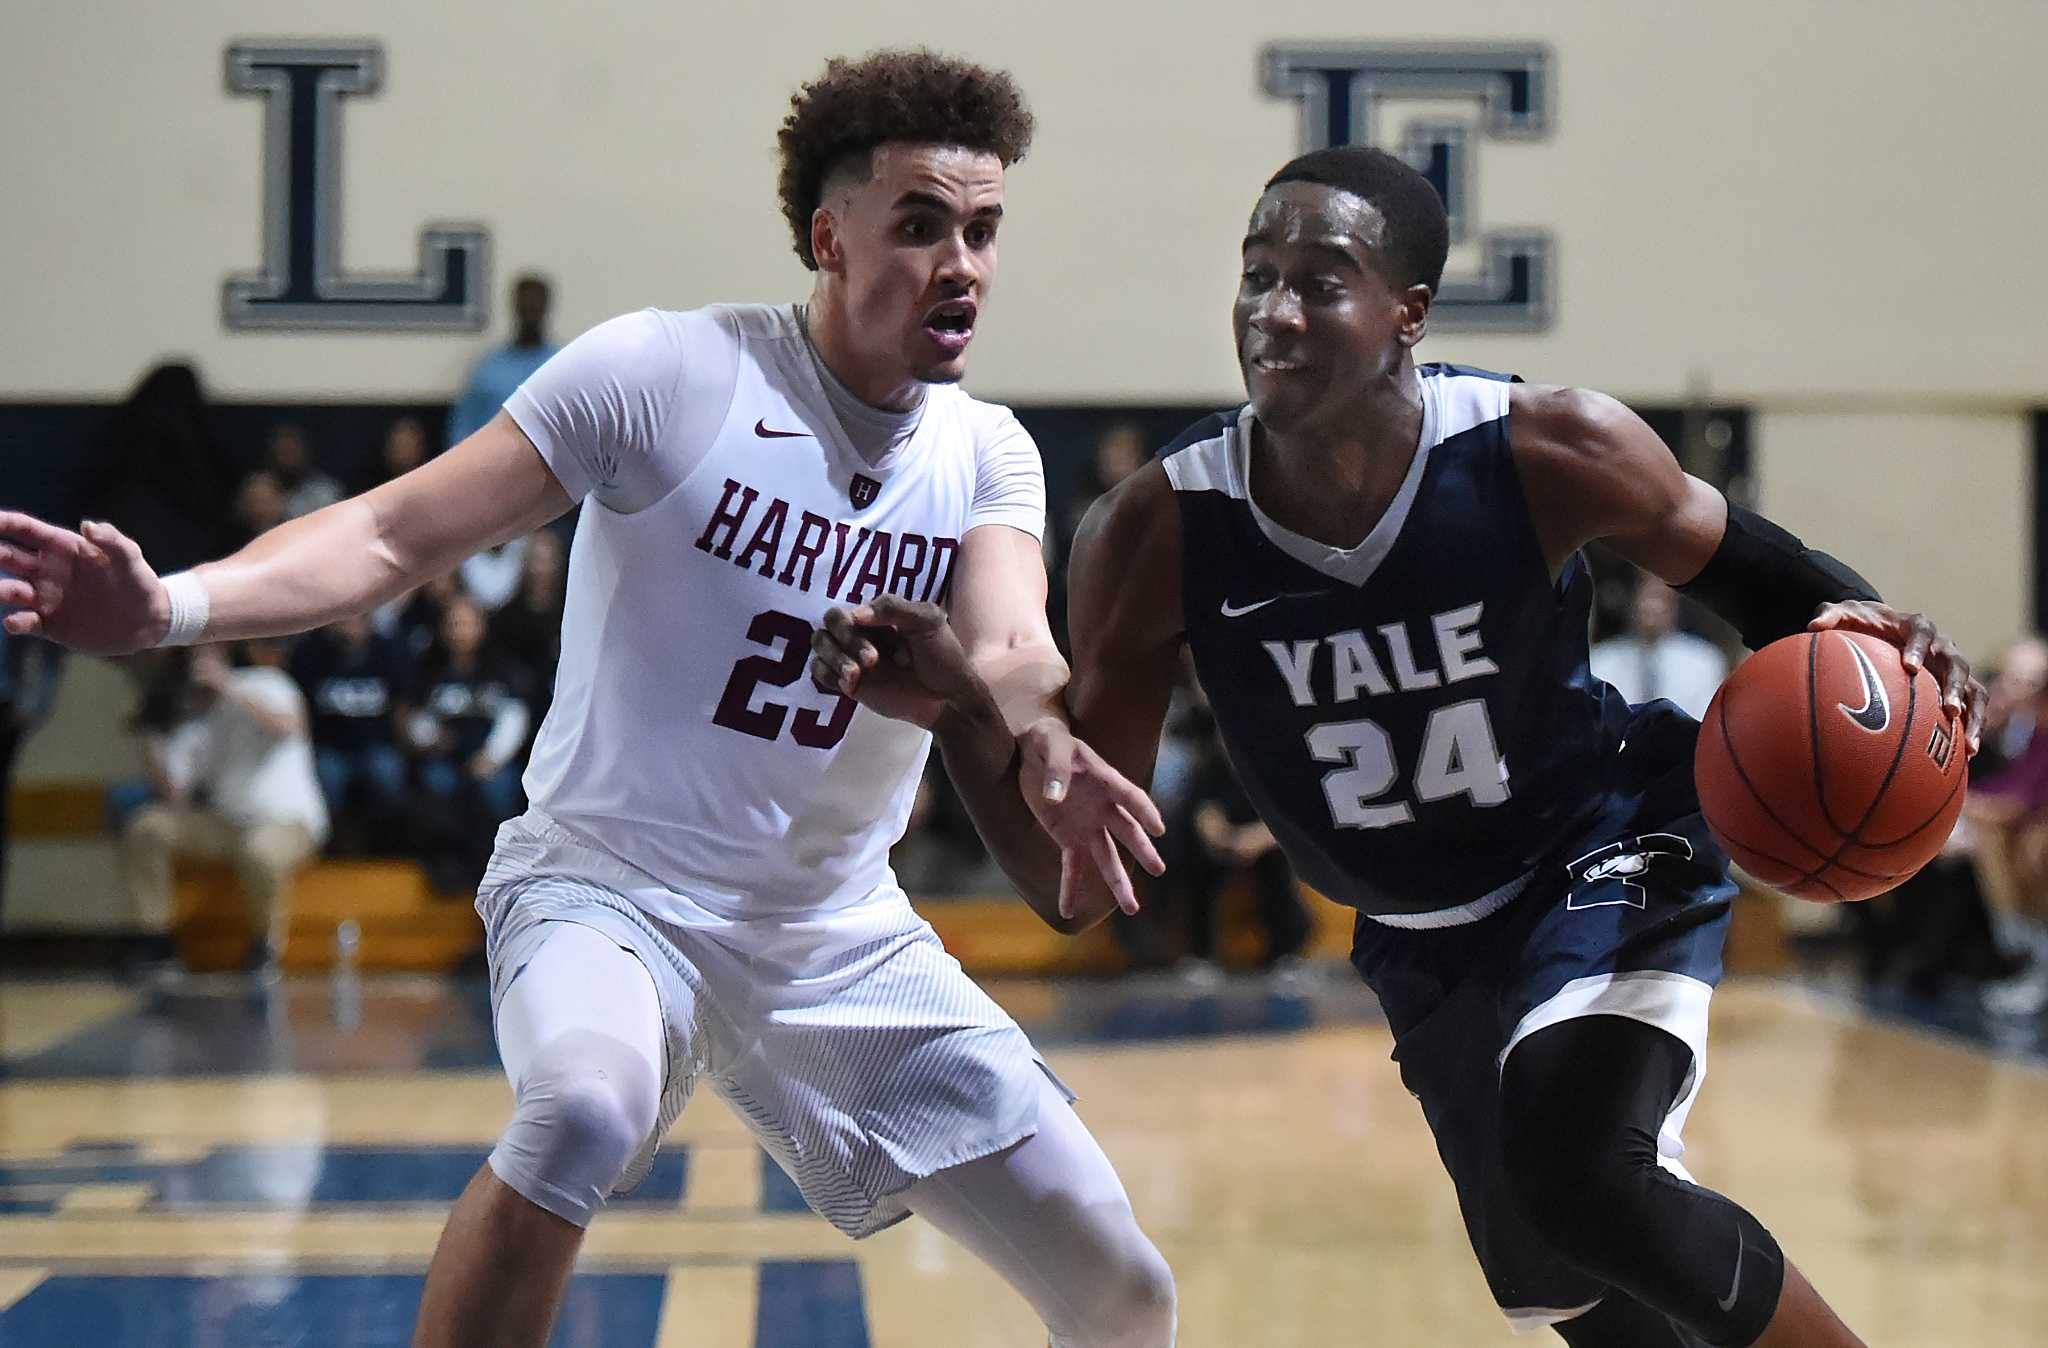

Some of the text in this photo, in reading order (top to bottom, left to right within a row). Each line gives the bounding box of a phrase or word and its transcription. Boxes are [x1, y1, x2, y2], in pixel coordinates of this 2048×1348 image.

[694, 477, 960, 607] HARVARD
[1261, 600, 1500, 707] YALE
[1303, 697, 1513, 830] 24
